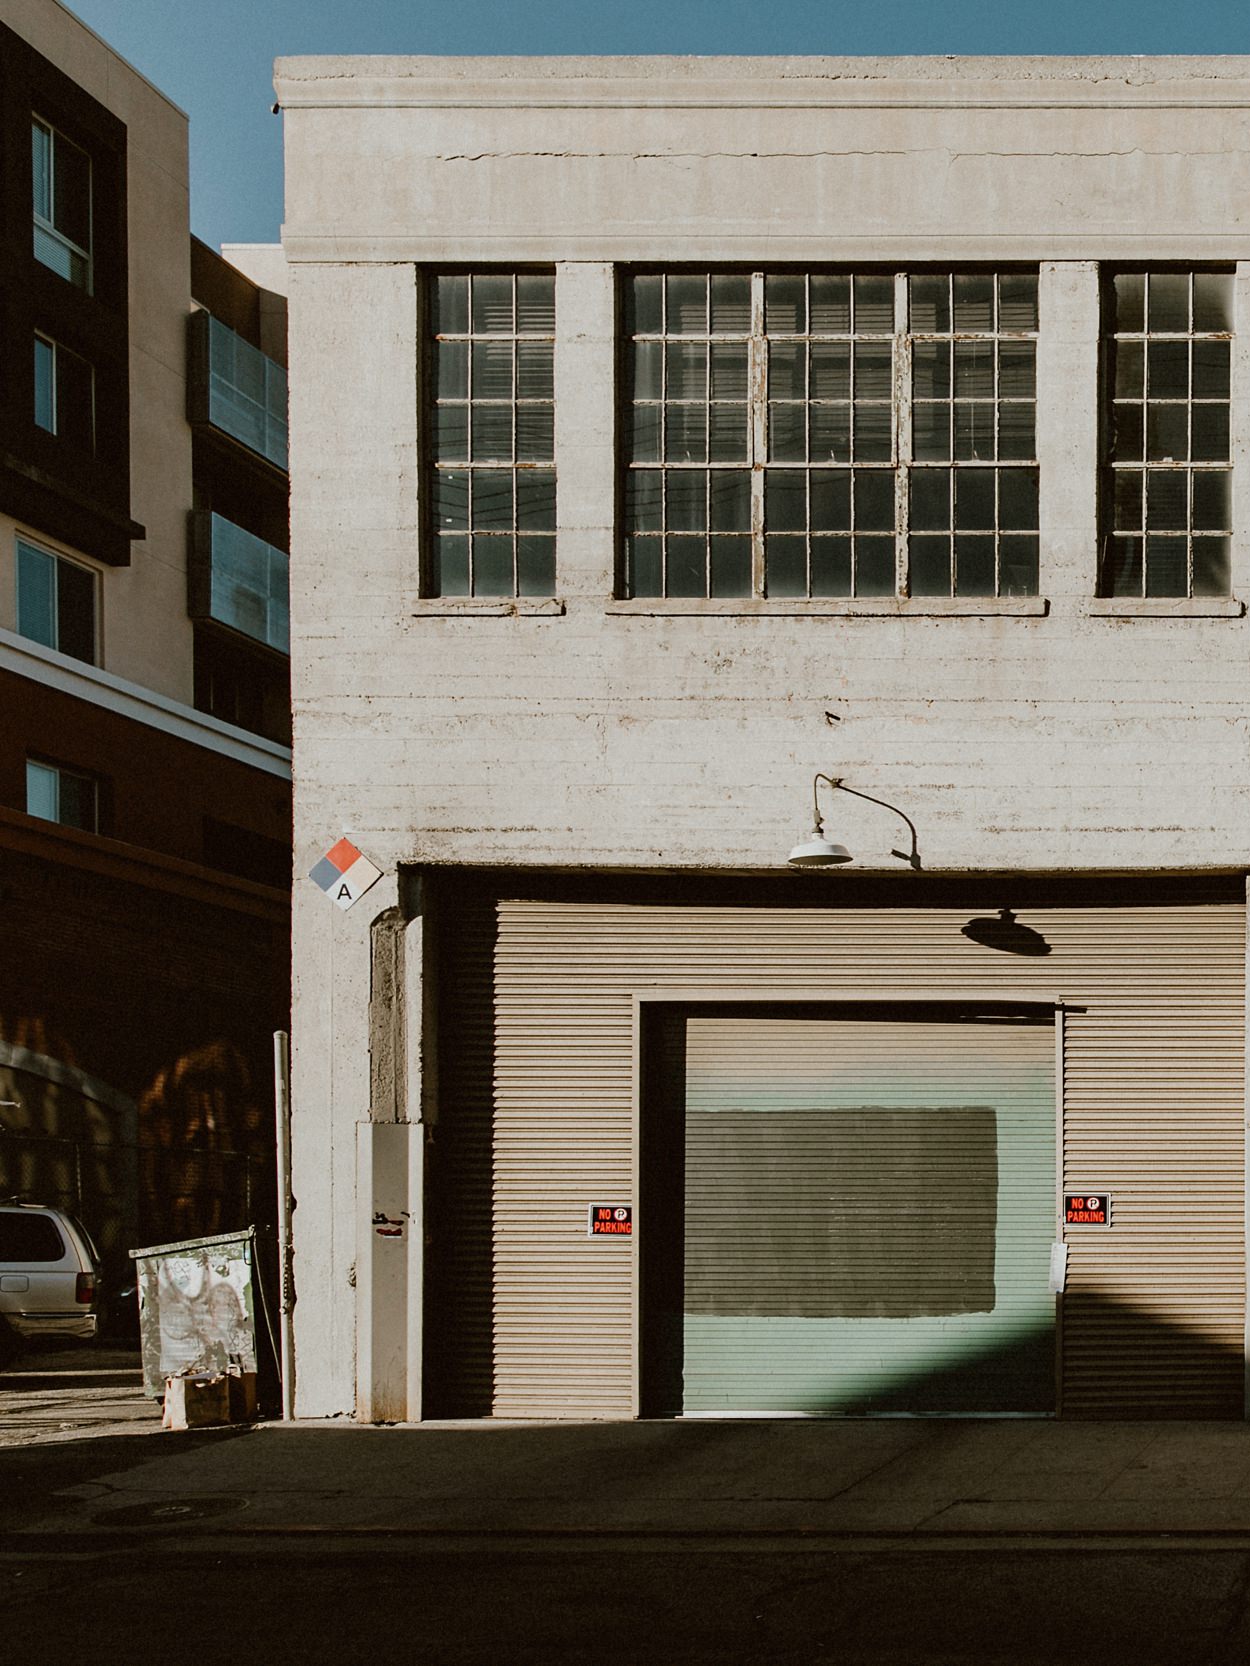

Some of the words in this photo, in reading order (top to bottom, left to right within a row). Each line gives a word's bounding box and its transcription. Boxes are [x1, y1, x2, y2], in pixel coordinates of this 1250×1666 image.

[336, 883, 353, 900] A
[1071, 1197, 1084, 1209] NO
[598, 1208, 611, 1220] NO
[1067, 1210, 1105, 1223] PARKING
[594, 1221, 632, 1233] PARKING
